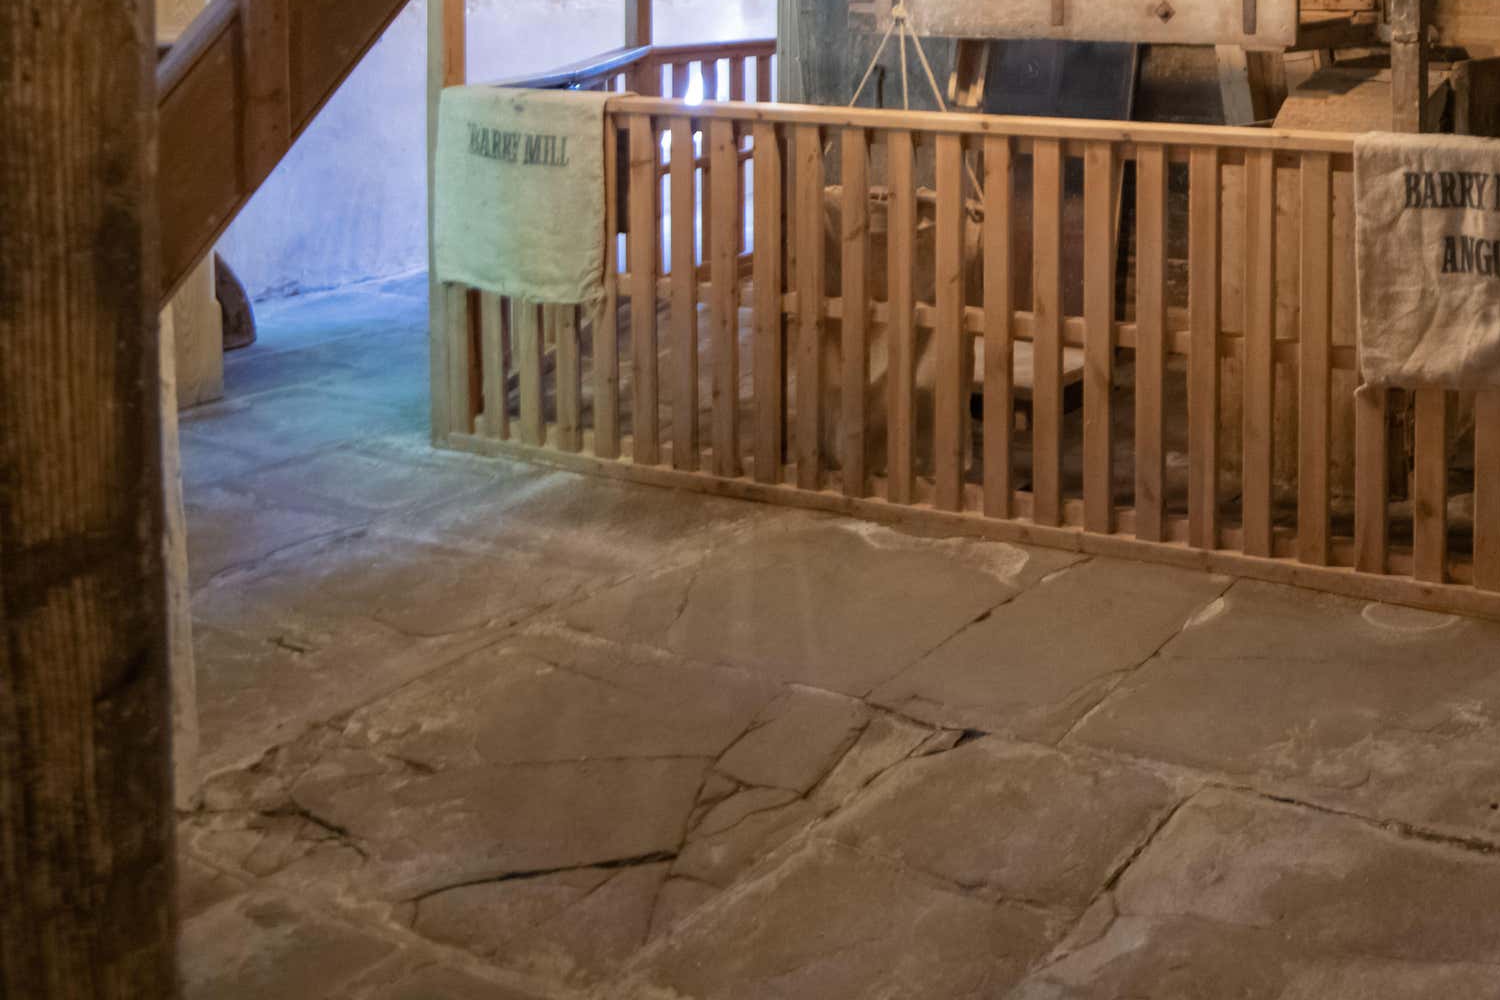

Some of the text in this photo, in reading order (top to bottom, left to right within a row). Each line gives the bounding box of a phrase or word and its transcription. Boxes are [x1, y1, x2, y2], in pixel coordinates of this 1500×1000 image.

[466, 121, 570, 168] BARRY MILL
[1403, 169, 1489, 211] BARRY
